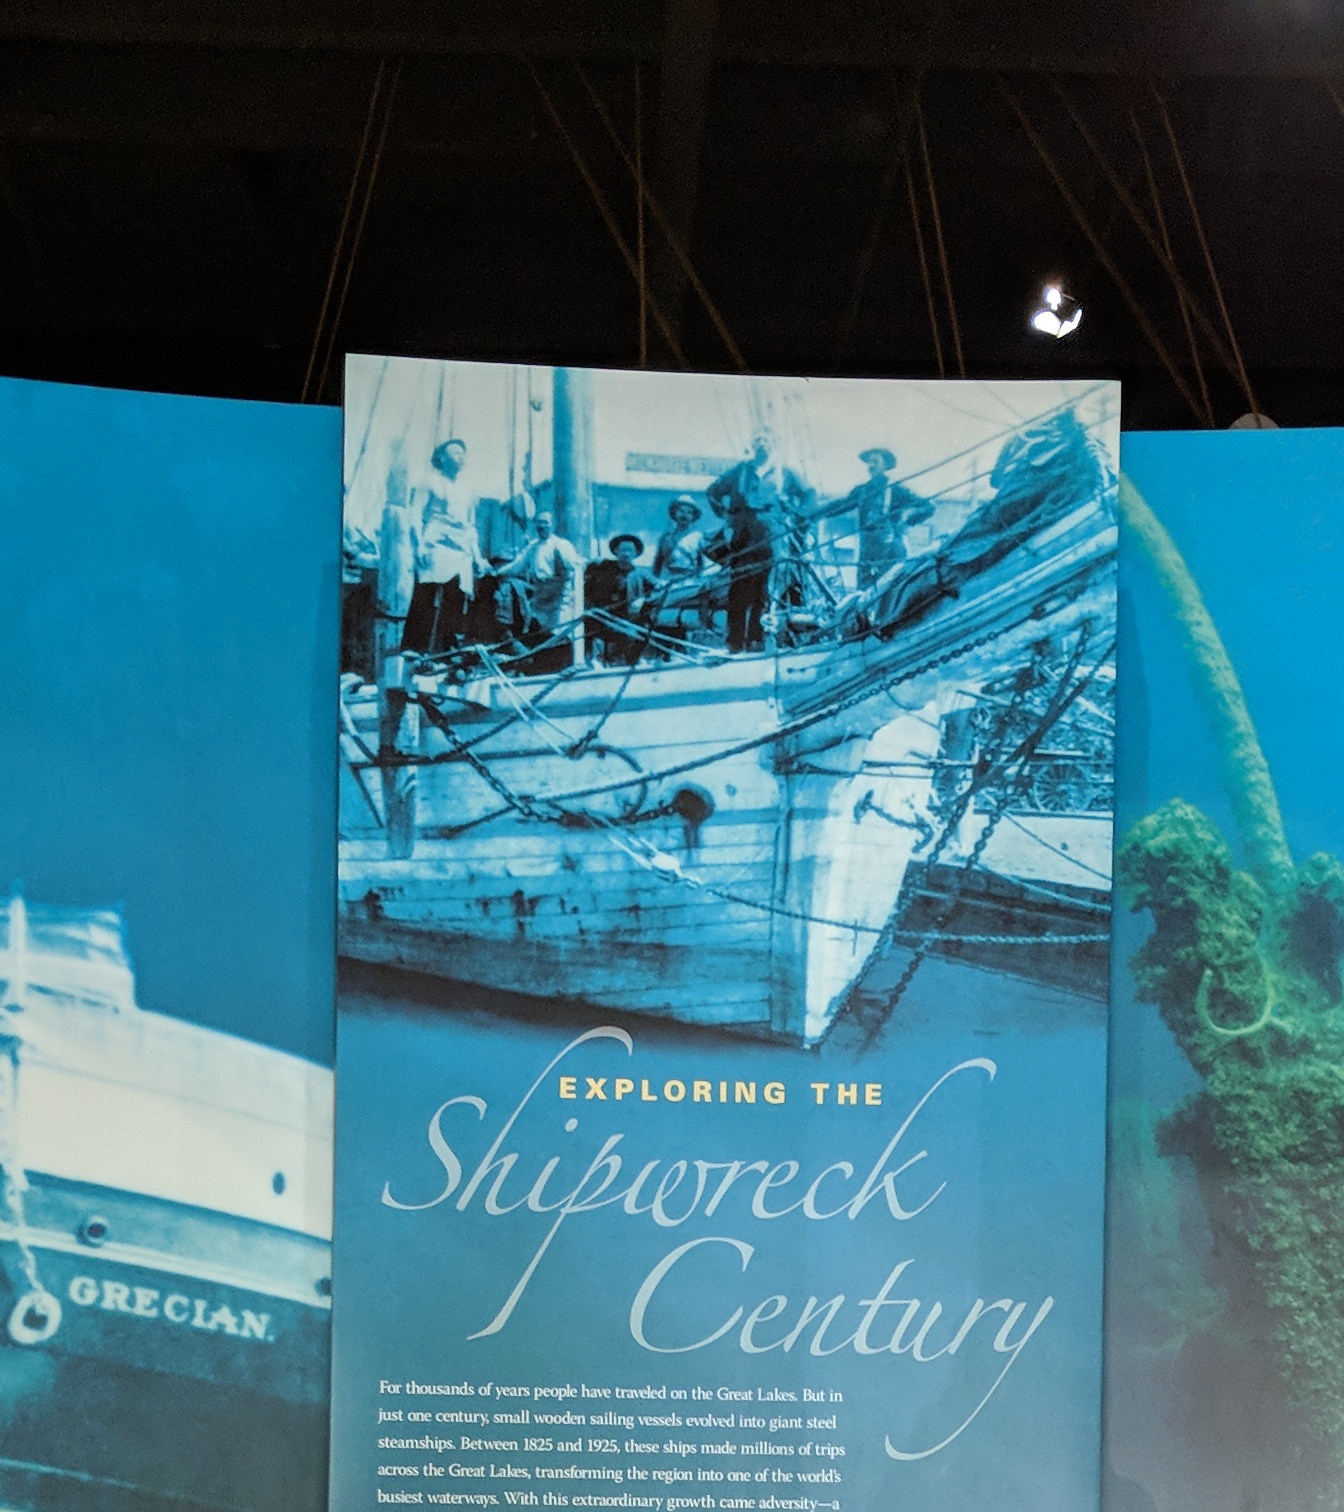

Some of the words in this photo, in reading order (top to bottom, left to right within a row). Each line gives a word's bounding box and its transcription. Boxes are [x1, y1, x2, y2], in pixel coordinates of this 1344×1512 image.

[558, 1075, 786, 1105] EXPLORING
[811, 1081, 882, 1106] THE
[380, 1025, 997, 1342] Shipwreck
[628, 1236, 1055, 1461] Century
[379, 1379, 403, 1395] For
[405, 1380, 476, 1397] thousands
[477, 1381, 494, 1397] of
[495, 1385, 531, 1401] years
[533, 1383, 579, 1402] people
[581, 1383, 612, 1399] have
[614, 1384, 667, 1400] traveled
[669, 1389, 688, 1401] on
[691, 1385, 714, 1401] the
[716, 1386, 754, 1402] Great
[756, 1387, 799, 1402] Lakes.
[802, 1388, 826, 1403] But
[829, 1389, 843, 1403] in
[377, 1407, 404, 1425] just
[406, 1411, 433, 1423] one
[434, 1410, 490, 1427] century,
[492, 1409, 531, 1425] small
[533, 1410, 587, 1426] wooden
[589, 1411, 635, 1430] sailing
[637, 1412, 683, 1427] vessels
[685, 1413, 736, 1428] evolved
[739, 1414, 767, 1430] into
[768, 1415, 803, 1433] giant
[806, 1414, 837, 1430] steel
[377, 1434, 457, 1454] steamships.
[459, 1435, 519, 1452] Between
[523, 1436, 554, 1452] 1825
[556, 1437, 583, 1452] and
[586, 1438, 621, 1454] 1925,
[624, 1438, 660, 1454] these
[662, 1438, 698, 1458] ships
[700, 1440, 738, 1455] made
[740, 1440, 795, 1456] millions
[797, 1441, 814, 1456] of
[814, 1442, 846, 1460] trips
[377, 1465, 420, 1477] across
[422, 1462, 446, 1477] the
[447, 1462, 486, 1478] Great
[488, 1463, 532, 1480] Lakes,
[534, 1464, 624, 1484] transforming
[626, 1465, 649, 1481] the
[652, 1467, 694, 1485] region
[696, 1467, 725, 1482] into
[726, 1471, 752, 1482] one
[754, 1467, 771, 1483] of
[771, 1467, 794, 1483] the
[796, 1468, 842, 1483] world's
[377, 1488, 424, 1505] busiest
[426, 1492, 500, 1509] waterways.
[503, 1491, 539, 1506] With
[542, 1491, 569, 1507] this
[571, 1492, 664, 1512] extraordinary
[666, 1494, 716, 1512] growth
[718, 1498, 756, 1509] came
